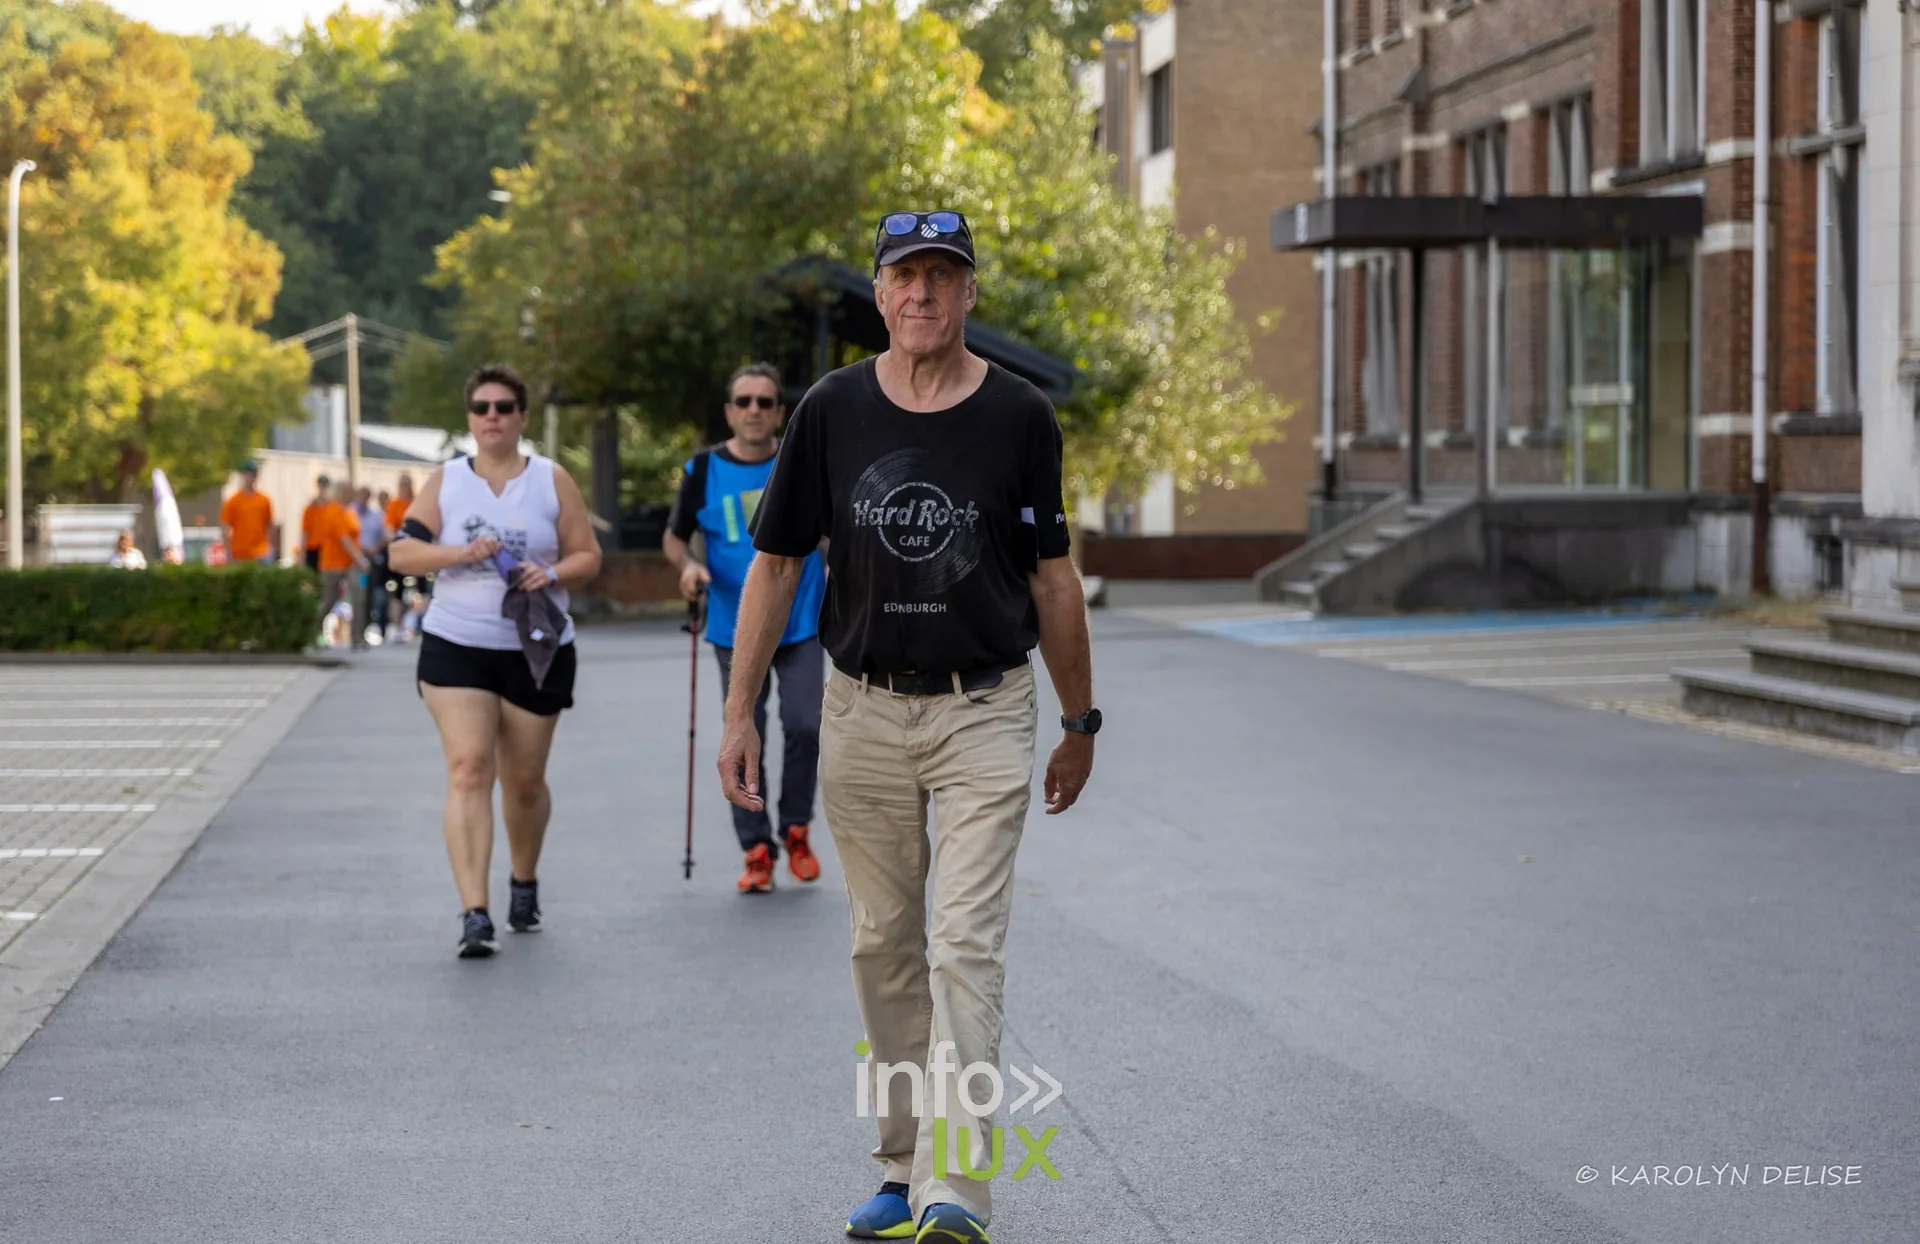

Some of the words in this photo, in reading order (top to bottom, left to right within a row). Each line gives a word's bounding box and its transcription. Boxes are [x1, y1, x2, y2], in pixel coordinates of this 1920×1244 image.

[853, 498, 917, 527] Hard
[917, 499, 980, 533] Rock
[899, 535, 930, 547] CAFE
[883, 602, 947, 613] EDNBURGH
